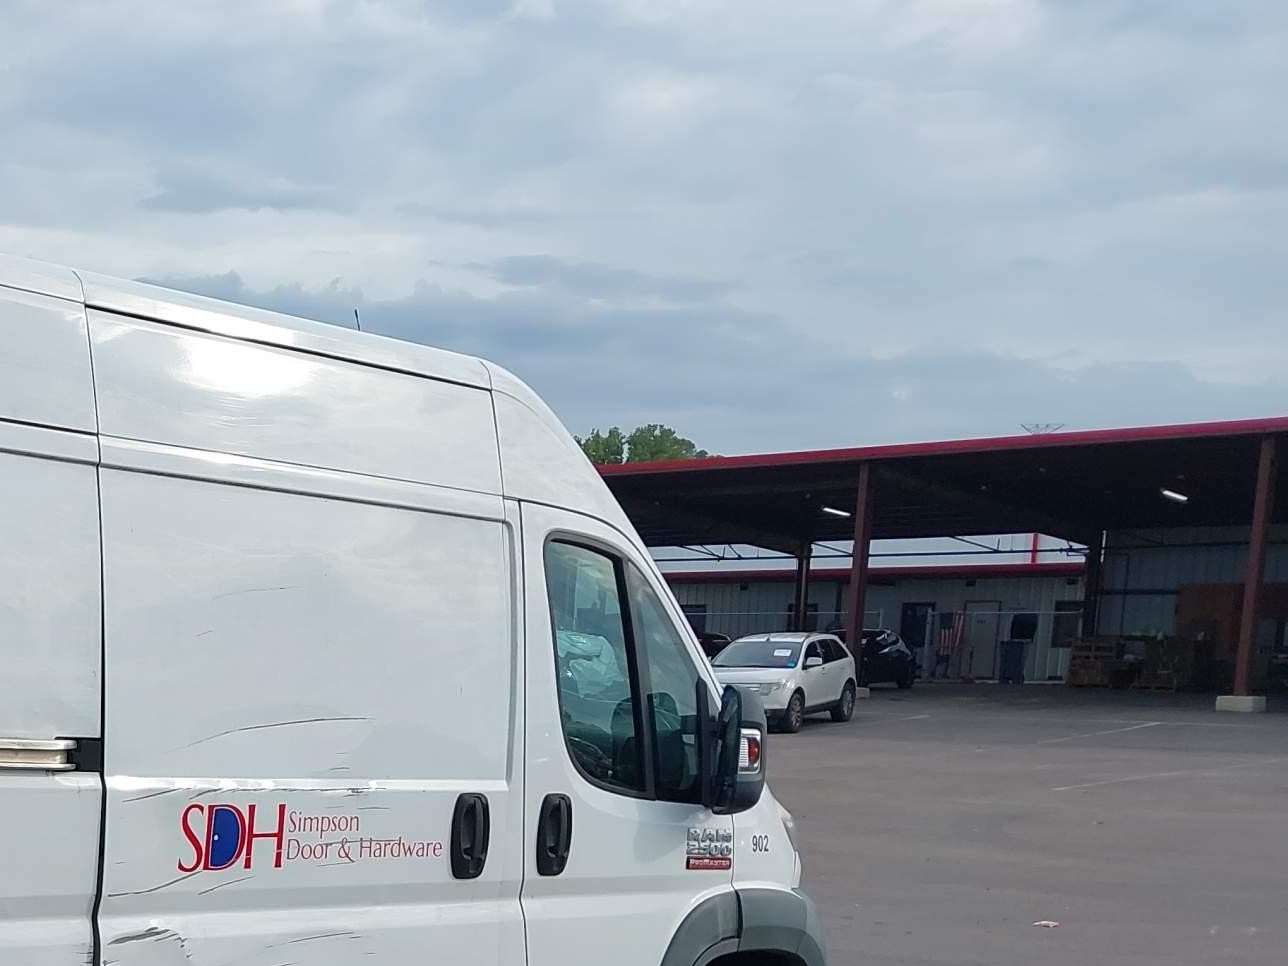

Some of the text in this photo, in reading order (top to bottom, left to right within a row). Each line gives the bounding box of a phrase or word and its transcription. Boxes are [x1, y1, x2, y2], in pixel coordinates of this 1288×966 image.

[177, 803, 287, 873] SDH
[288, 811, 360, 838] Simpson
[286, 835, 443, 863] Door & Hardware
[686, 841, 732, 856] 2500
[751, 835, 769, 853] 902
